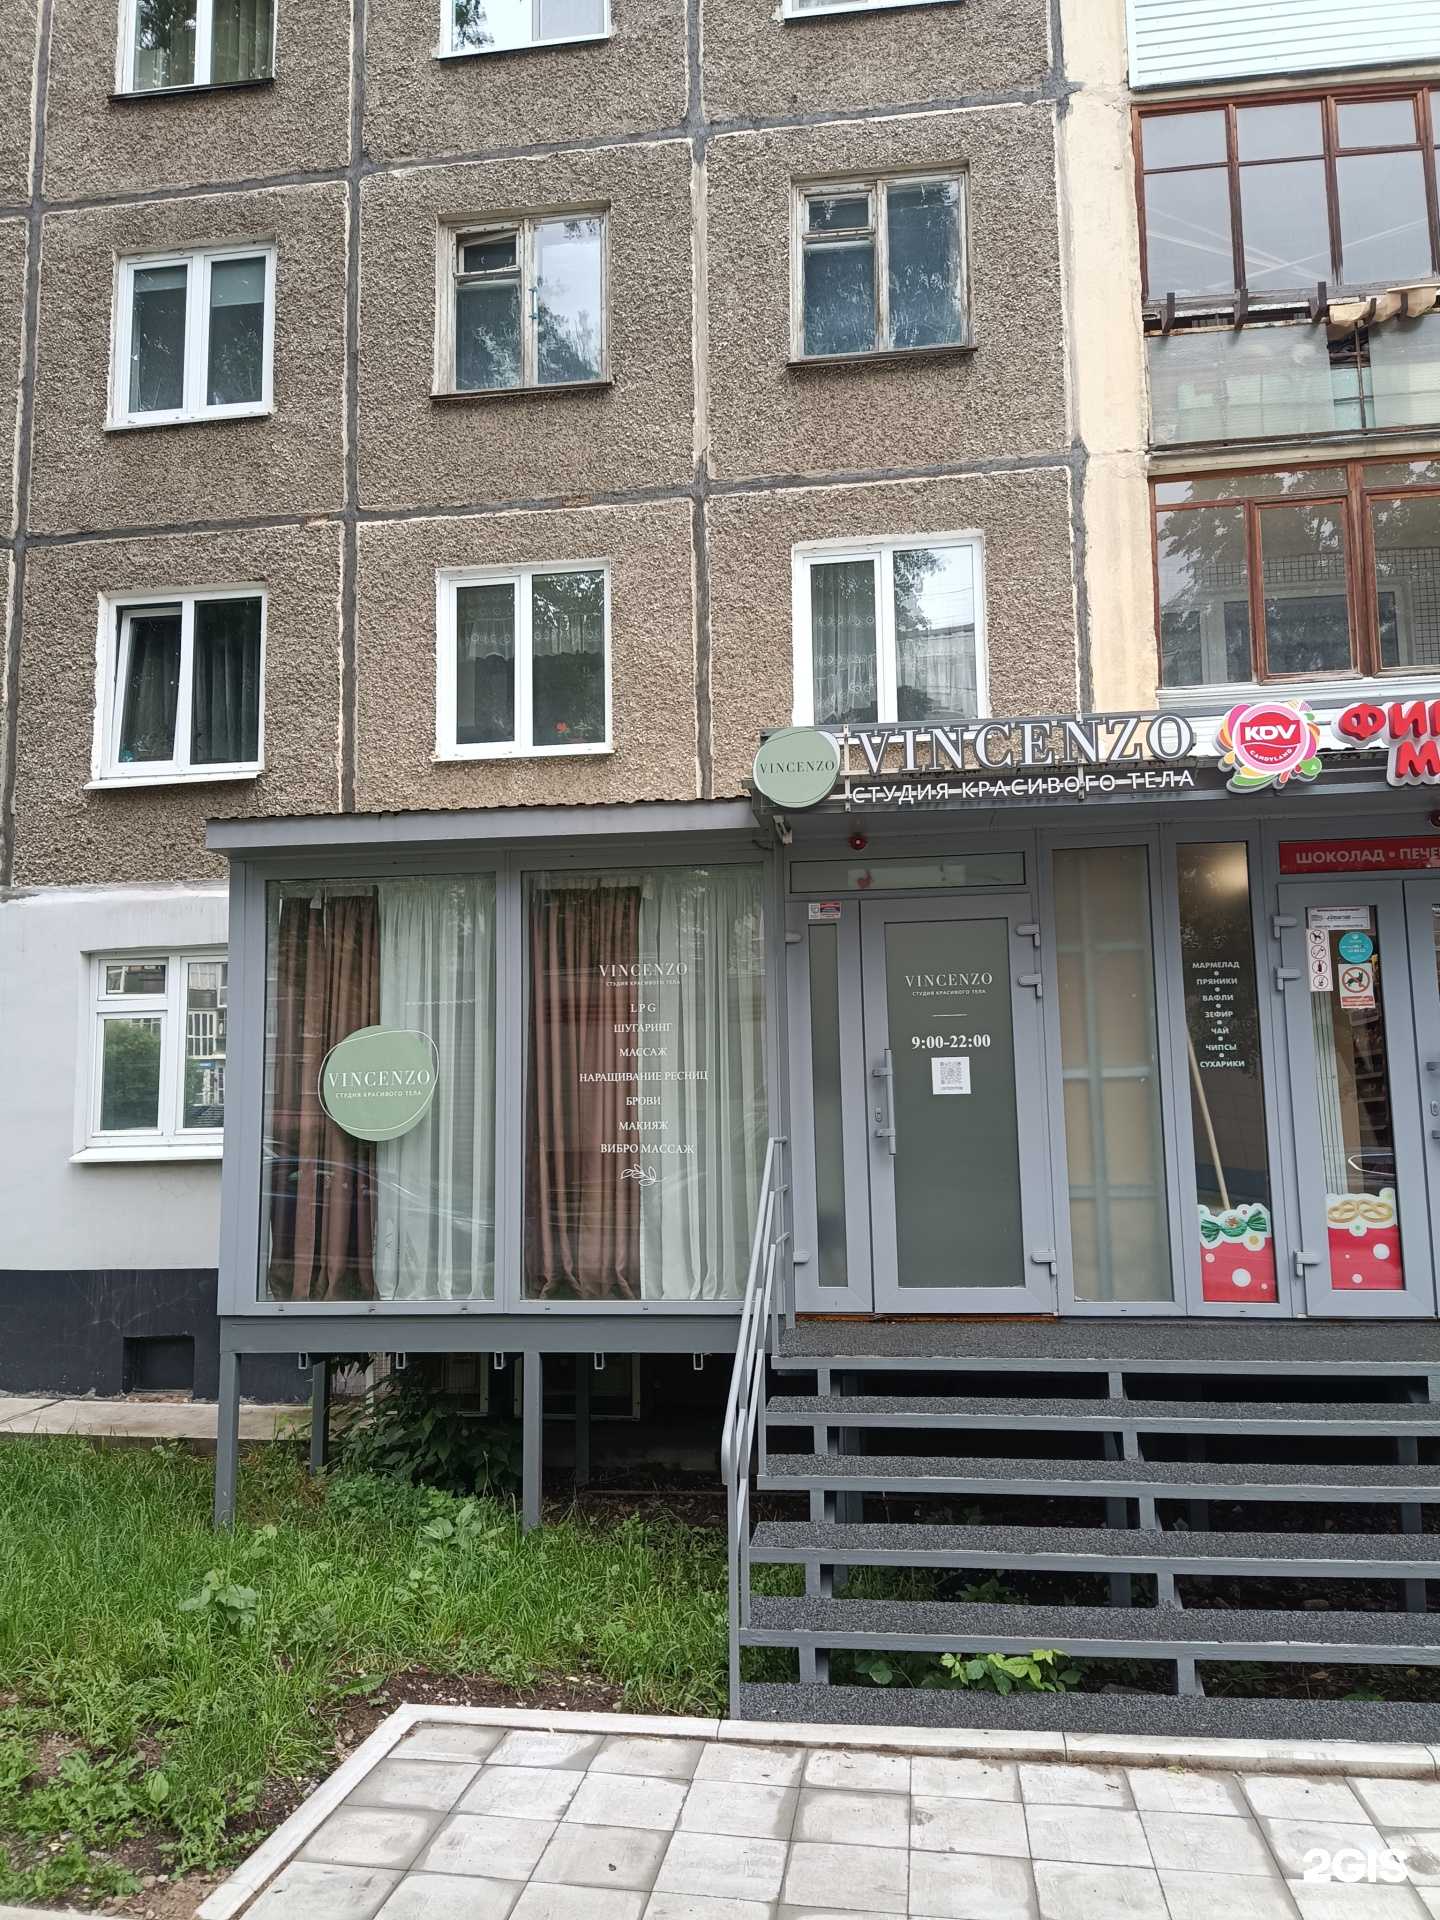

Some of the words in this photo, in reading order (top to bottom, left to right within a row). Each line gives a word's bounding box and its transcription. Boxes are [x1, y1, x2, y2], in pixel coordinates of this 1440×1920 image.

[1244, 724, 1297, 741] KDV
[851, 713, 1194, 777] VINCENZO
[1250, 748, 1293, 762] CANDYLAND
[760, 761, 835, 774] VINCENZO
[852, 782, 949, 805] СТУДИЯ
[962, 773, 1116, 798] КРАСИВОГО
[1127, 769, 1195, 790] ТЕЛА
[1296, 850, 1384, 864] ШОКОЛАД
[1400, 847, 1440, 860] ПЕЧЕ
[600, 962, 688, 977] VINCENZO
[1192, 961, 1240, 969] МАРМЕЛАД
[905, 972, 993, 988] VINCENZO
[630, 1003, 657, 1013] LPG
[1204, 1010, 1234, 1018] ЗЕФИР
[614, 1023, 673, 1033] ШУГАРИНГ
[1211, 1026, 1229, 1034] ЧАЙ
[911, 1033, 991, 1050] 9:00-22:00
[1206, 1043, 1237, 1051] ЧИПСЫ
[619, 1047, 668, 1057] МАССАЖ
[1199, 1060, 1246, 1068] СУХАРИКИ
[328, 1070, 431, 1088] VINCENZO
[579, 1071, 662, 1082] НАРАЩИВАНИЕ
[664, 1070, 709, 1081] РЕСНИЦ
[626, 1096, 662, 1106] БРОВИ
[618, 1120, 669, 1131] МАКИЯЖ
[600, 1143, 639, 1154] ВИБРО
[640, 1143, 696, 1154] МАССАЖ
